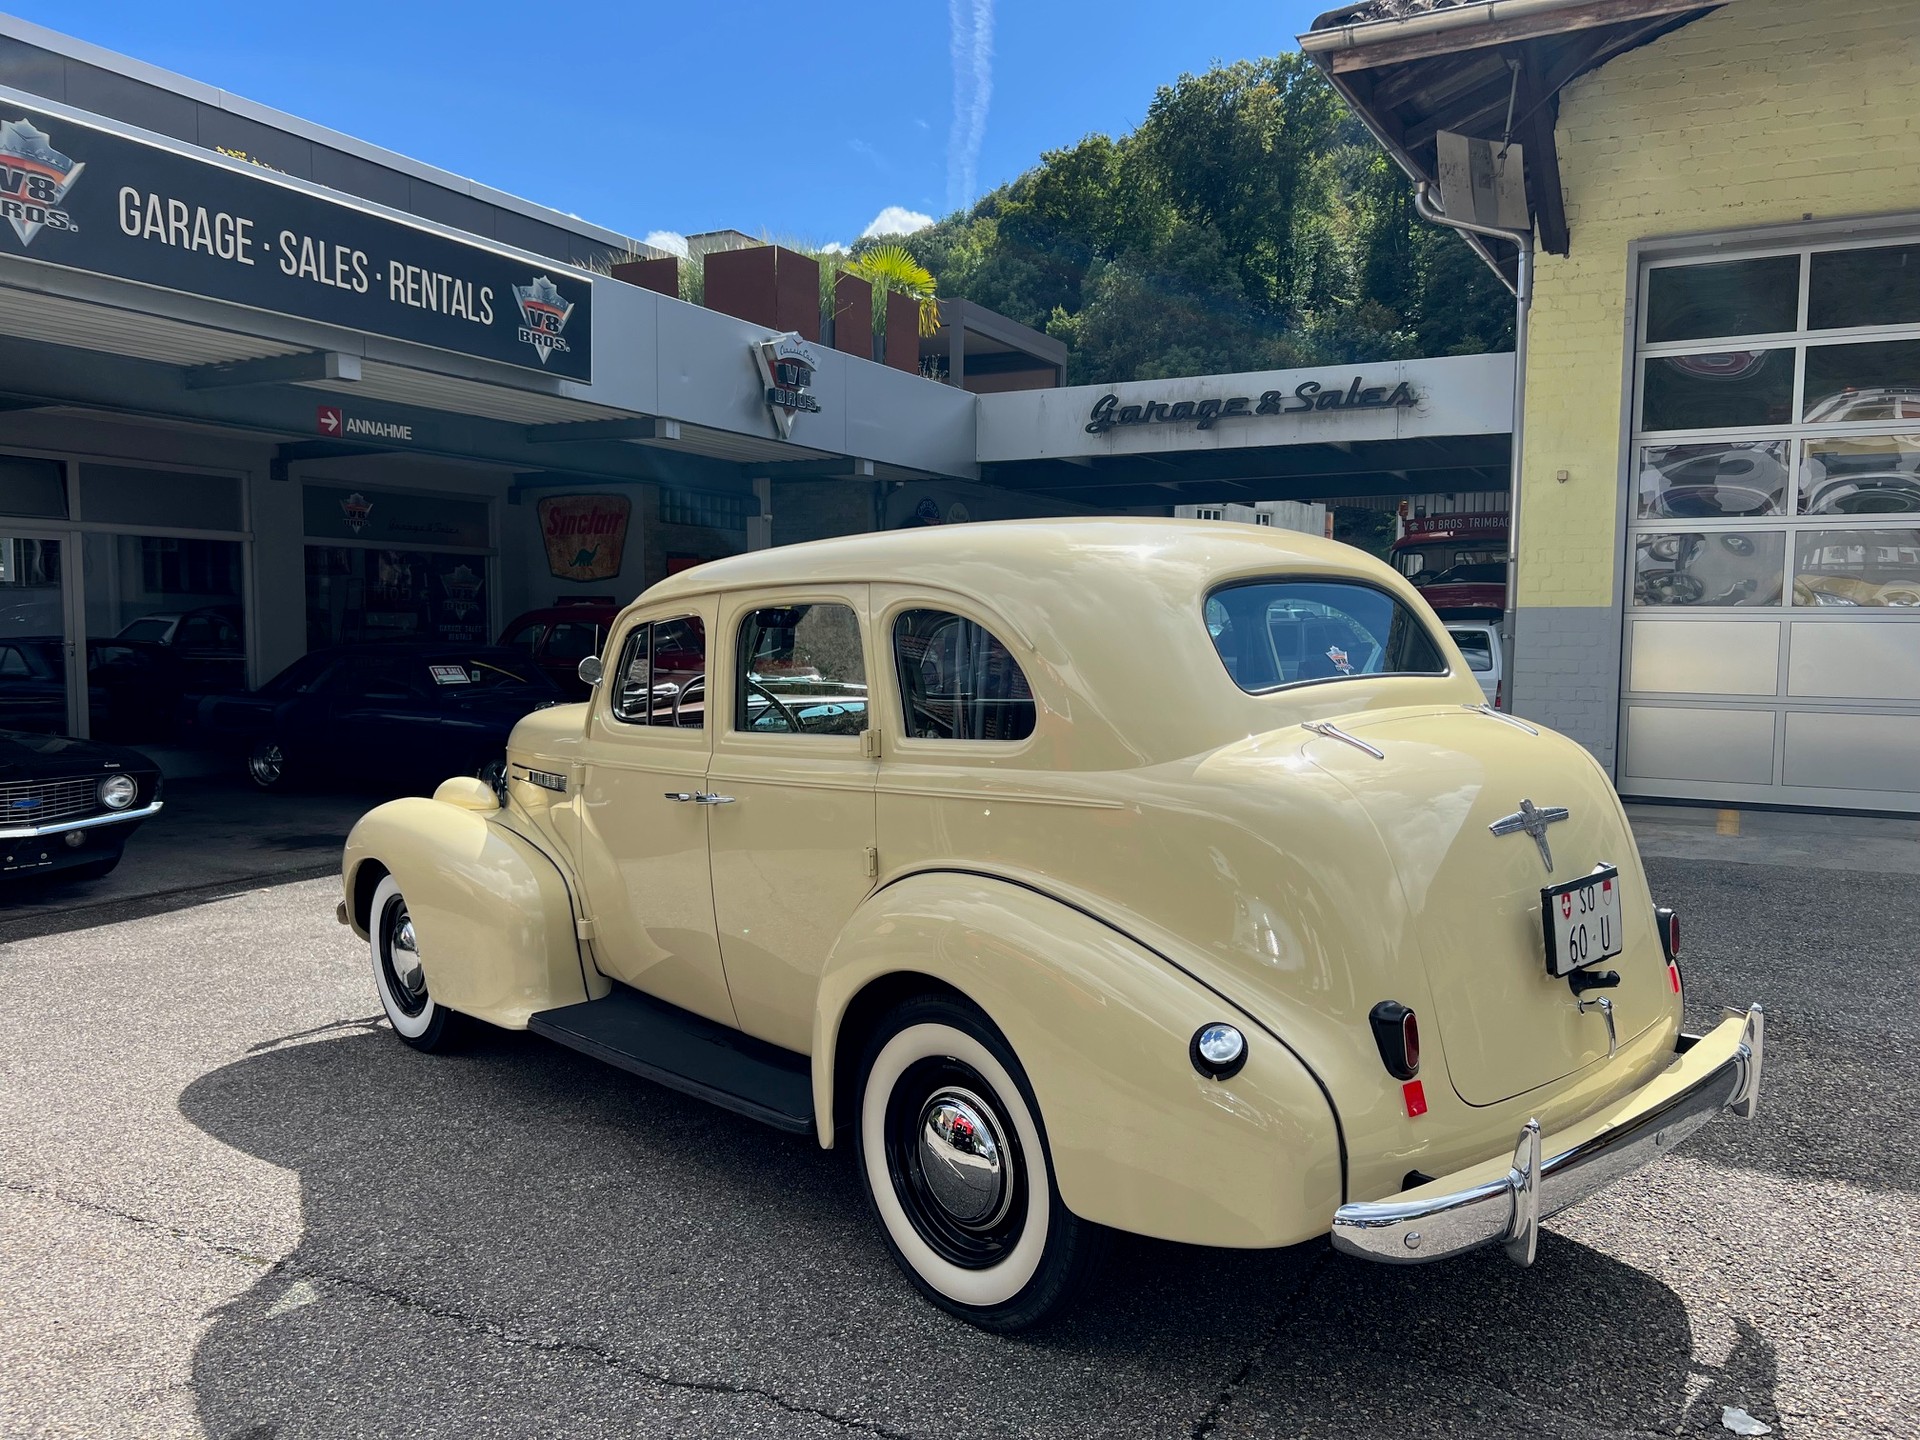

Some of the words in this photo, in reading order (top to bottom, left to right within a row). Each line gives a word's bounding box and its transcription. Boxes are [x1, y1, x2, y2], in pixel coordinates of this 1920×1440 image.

[0, 164, 58, 204] V8
[0, 199, 79, 232] ROS.
[118, 186, 255, 265] GARAGE
[279, 230, 368, 293] SALES
[390, 260, 494, 326] RENTALS
[527, 308, 561, 334] V8
[518, 327, 571, 352] BROS.
[784, 363, 811, 388] V8
[1085, 393, 1251, 433] Garage
[1256, 390, 1281, 415] &
[1284, 376, 1420, 413] Sales
[346, 418, 413, 440] ANNAHME
[547, 506, 624, 536] Sinclair
[1424, 520, 1435, 531] V8
[1579, 886, 1595, 914] SO
[1569, 924, 1588, 963] 60
[1600, 914, 1610, 951] U
